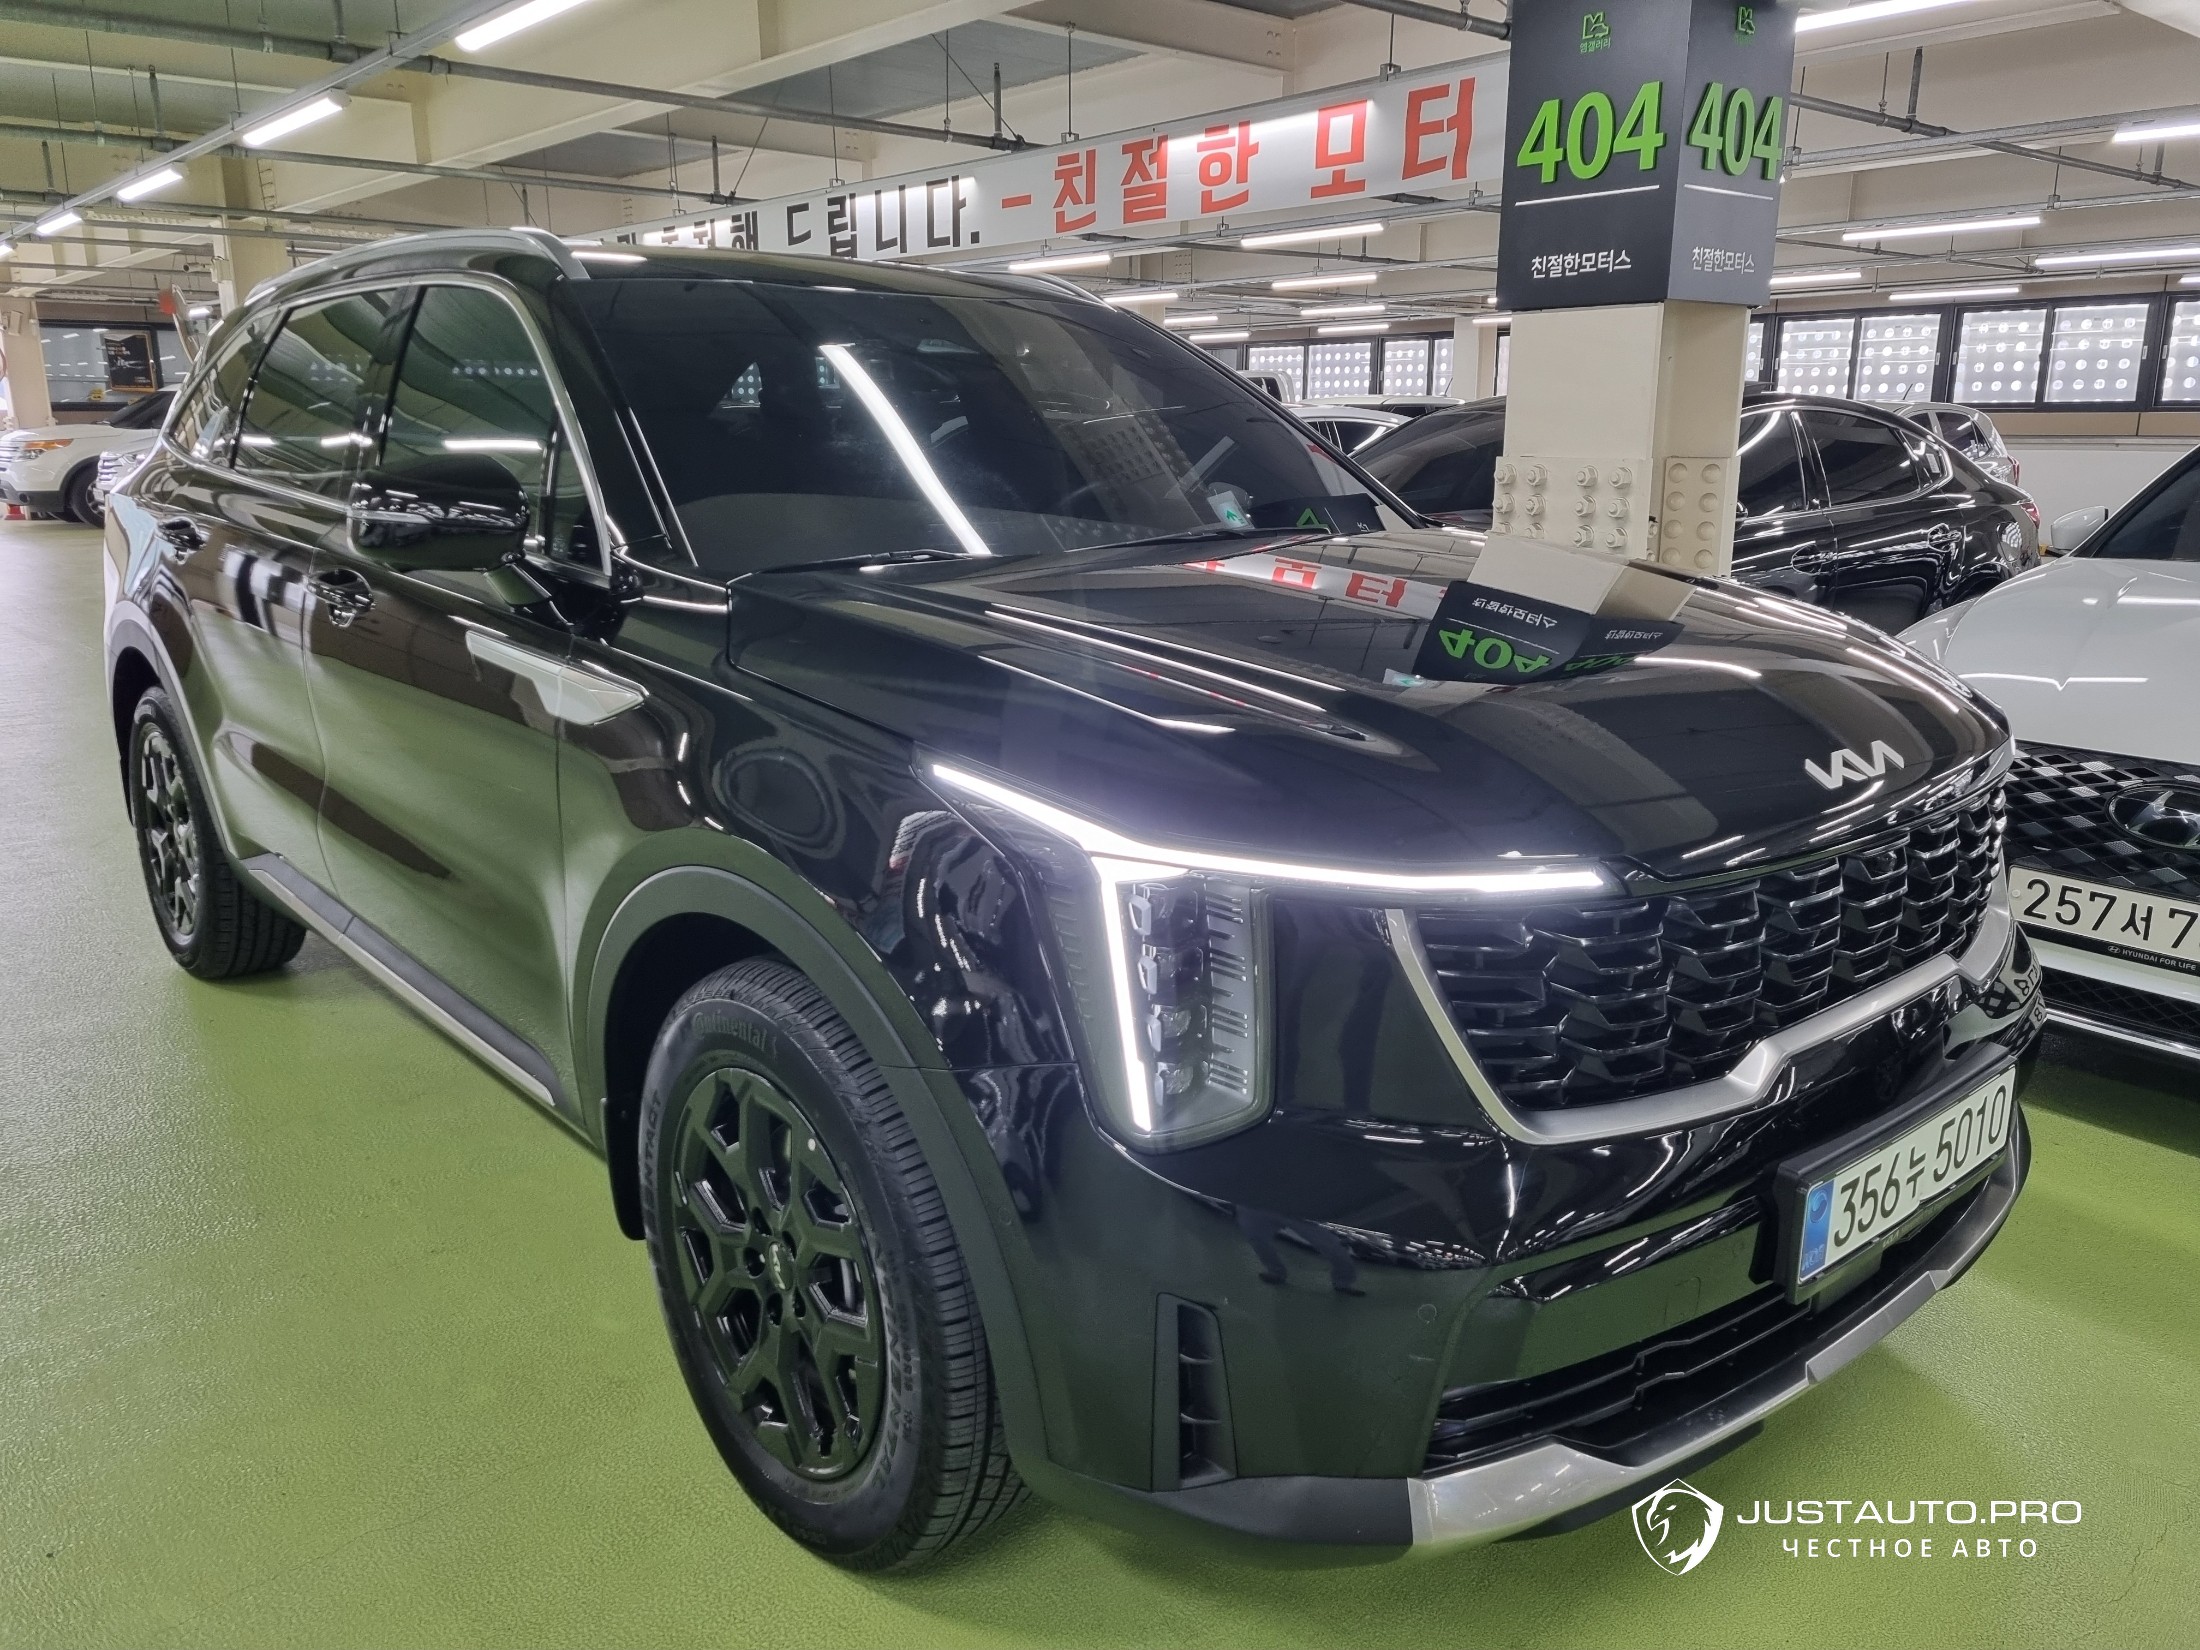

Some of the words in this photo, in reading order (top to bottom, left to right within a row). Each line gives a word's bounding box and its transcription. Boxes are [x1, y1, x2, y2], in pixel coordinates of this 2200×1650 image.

[1516, 81, 1666, 184] 404
[1687, 81, 1784, 181] 404
[1052, 119, 1260, 234] 친절한
[1531, 250, 1632, 279] 친절한모터스
[1692, 246, 1755, 275] 친절한모터스
[1804, 740, 1905, 789] KIA
[2023, 878, 2153, 942] 257서
[2168, 907, 2200, 949] 7
[2122, 949, 2158, 962] HYUNDAI
[2159, 957, 2177, 967] FOR
[2178, 962, 2197, 971] LIFE
[1833, 1146, 1927, 1248] 356누
[1933, 1084, 2007, 1183] 5010
